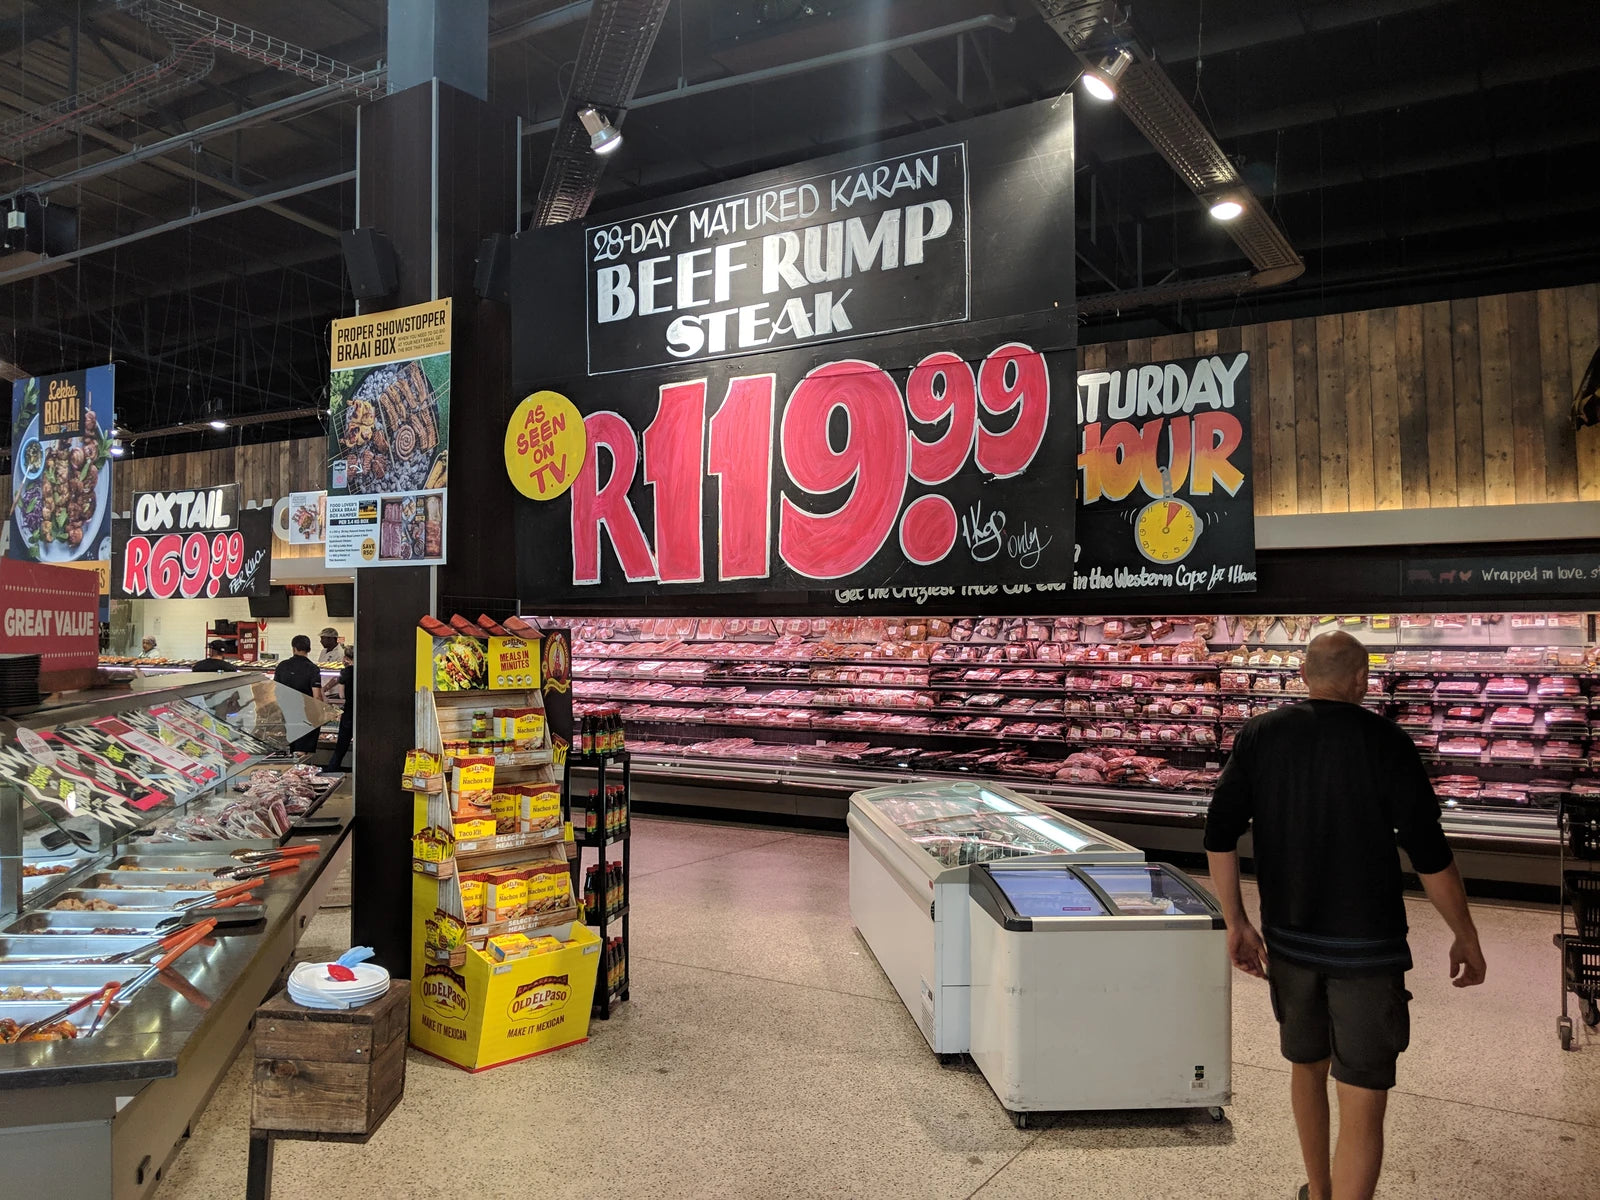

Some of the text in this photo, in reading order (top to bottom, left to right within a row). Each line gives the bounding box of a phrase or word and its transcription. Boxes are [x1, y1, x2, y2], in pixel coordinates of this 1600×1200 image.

[593, 154, 939, 262] 28-DAY MATURED KARAN
[596, 199, 953, 324] BEEF RUMP
[337, 310, 445, 344] PROPER SHOWSTOPPER
[665, 288, 854, 358] STEAK
[337, 336, 396, 362] BRAAI BOX
[48, 379, 79, 401] Lekka
[1077, 352, 1249, 424] TURDAY
[44, 397, 80, 426] BRAAI
[524, 405, 546, 430] AS
[516, 412, 567, 456] SEEN
[533, 440, 555, 465] ON
[135, 489, 231, 532] OXTAIL
[1007, 520, 1053, 569] only
[1072, 571, 1088, 590] in
[1089, 566, 1113, 590] the
[1114, 566, 1173, 589] Western
[1207, 564, 1226, 591] for
[1481, 566, 1537, 583] Wrapped
[1542, 569, 1553, 579] in
[4, 608, 95, 637] GREAT VALUE
[500, 650, 529, 662] MEALS IN
[500, 660, 530, 672] MINUTES
[462, 777, 484, 785] Nachos
[499, 893, 518, 902] Nachos
[508, 916, 532, 926] SELECT
[508, 924, 526, 933] MEAL
[423, 981, 437, 996] OLD
[512, 997, 532, 1014] OLD
[421, 1014, 467, 1041] MAKE IT MEXICAN
[507, 1014, 565, 1038] MAKE IT MEXICAN
